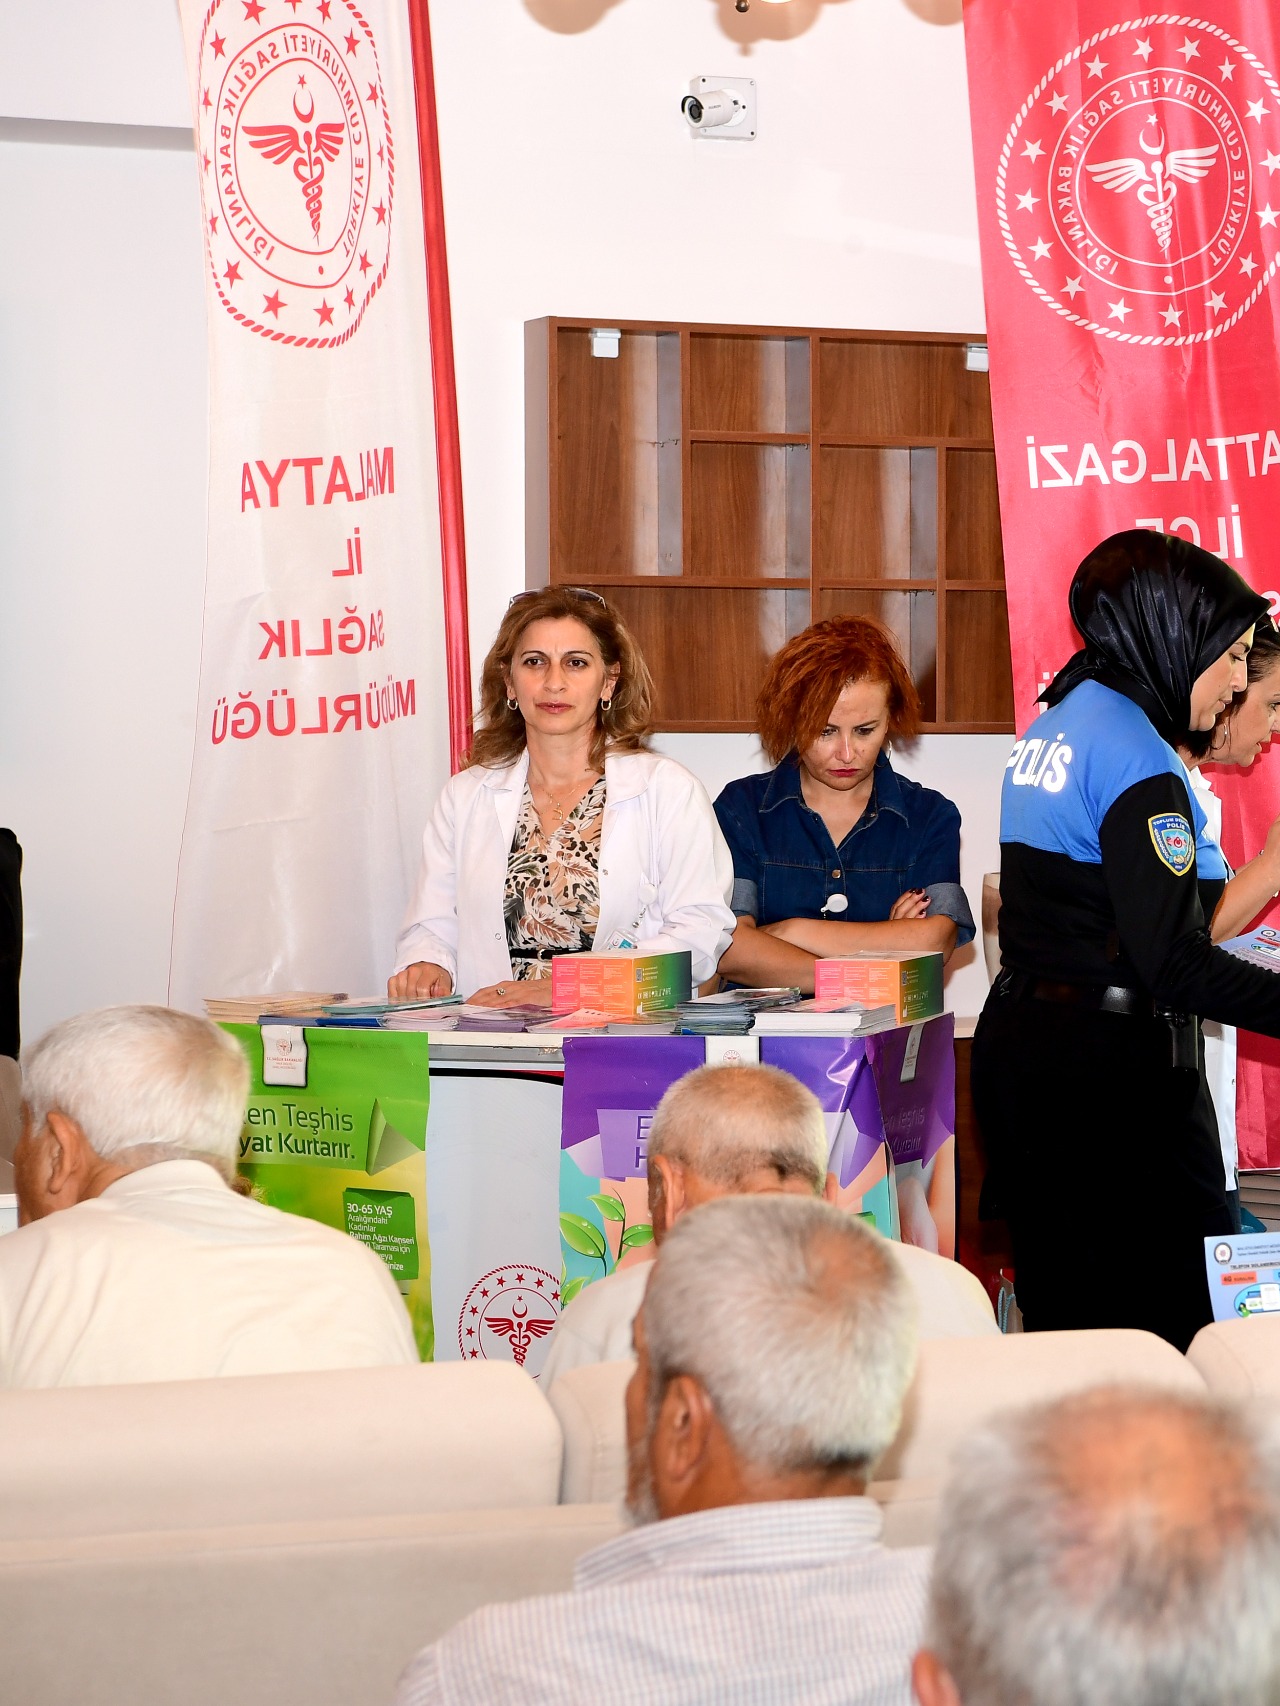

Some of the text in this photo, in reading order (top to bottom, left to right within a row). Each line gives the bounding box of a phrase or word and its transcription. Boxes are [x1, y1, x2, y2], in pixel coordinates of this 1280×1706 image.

[282, 1103, 354, 1136] Teşhis
[278, 1132, 355, 1159] Kurtarır.
[346, 1203, 393, 1218] 30-65 YAŞ
[348, 1213, 388, 1225] Aralığındaki
[348, 1222, 377, 1233] Kadınlar
[350, 1231, 415, 1245] Rahim Ağzı Kanseri
[379, 1253, 393, 1261] eya
[386, 1261, 404, 1271] inize
